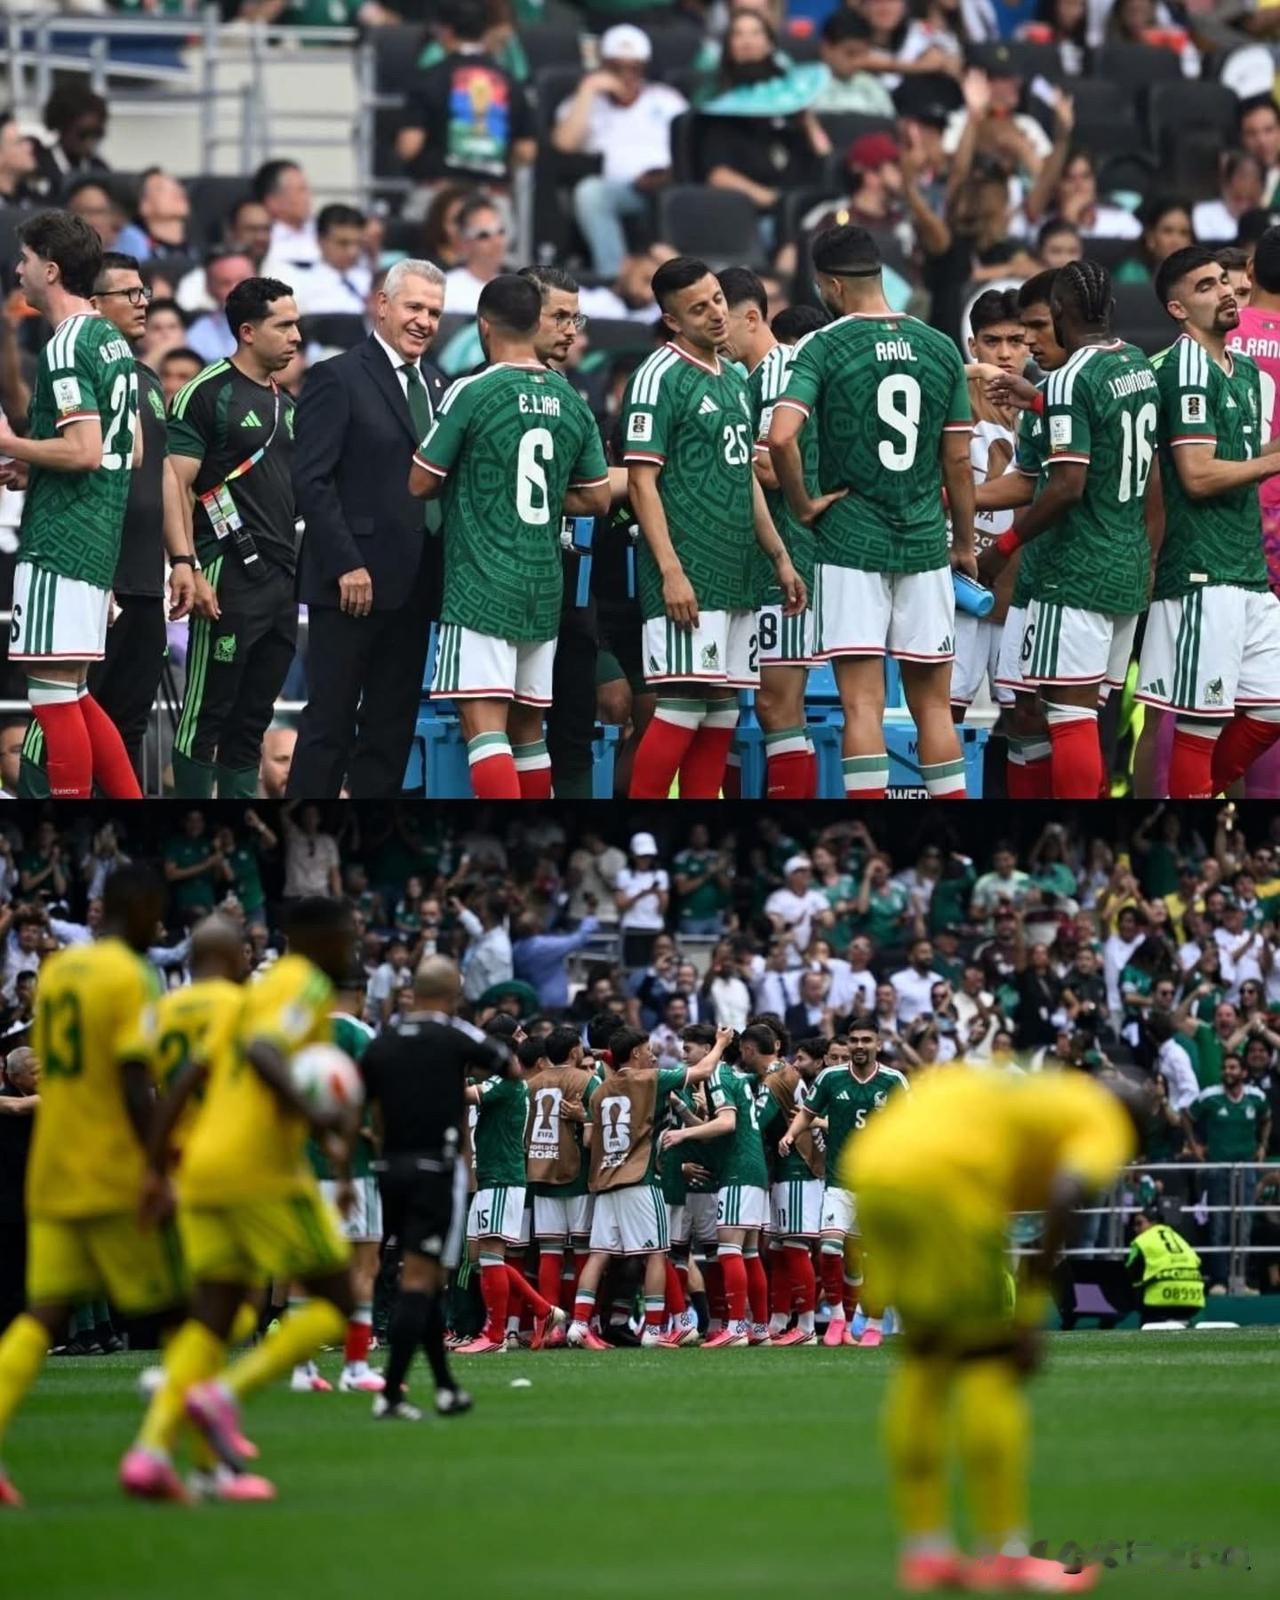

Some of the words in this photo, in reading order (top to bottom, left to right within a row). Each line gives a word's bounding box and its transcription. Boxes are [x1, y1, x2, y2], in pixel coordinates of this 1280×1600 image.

[875, 337, 918, 361] RAÚL
[519, 393, 560, 417] E.LIRA
[877, 373, 921, 471] 9
[723, 424, 749, 465] 25
[1118, 402, 1157, 503] 16
[516, 427, 554, 525] 6
[759, 612, 778, 650] 8
[477, 1209, 490, 1229] 15
